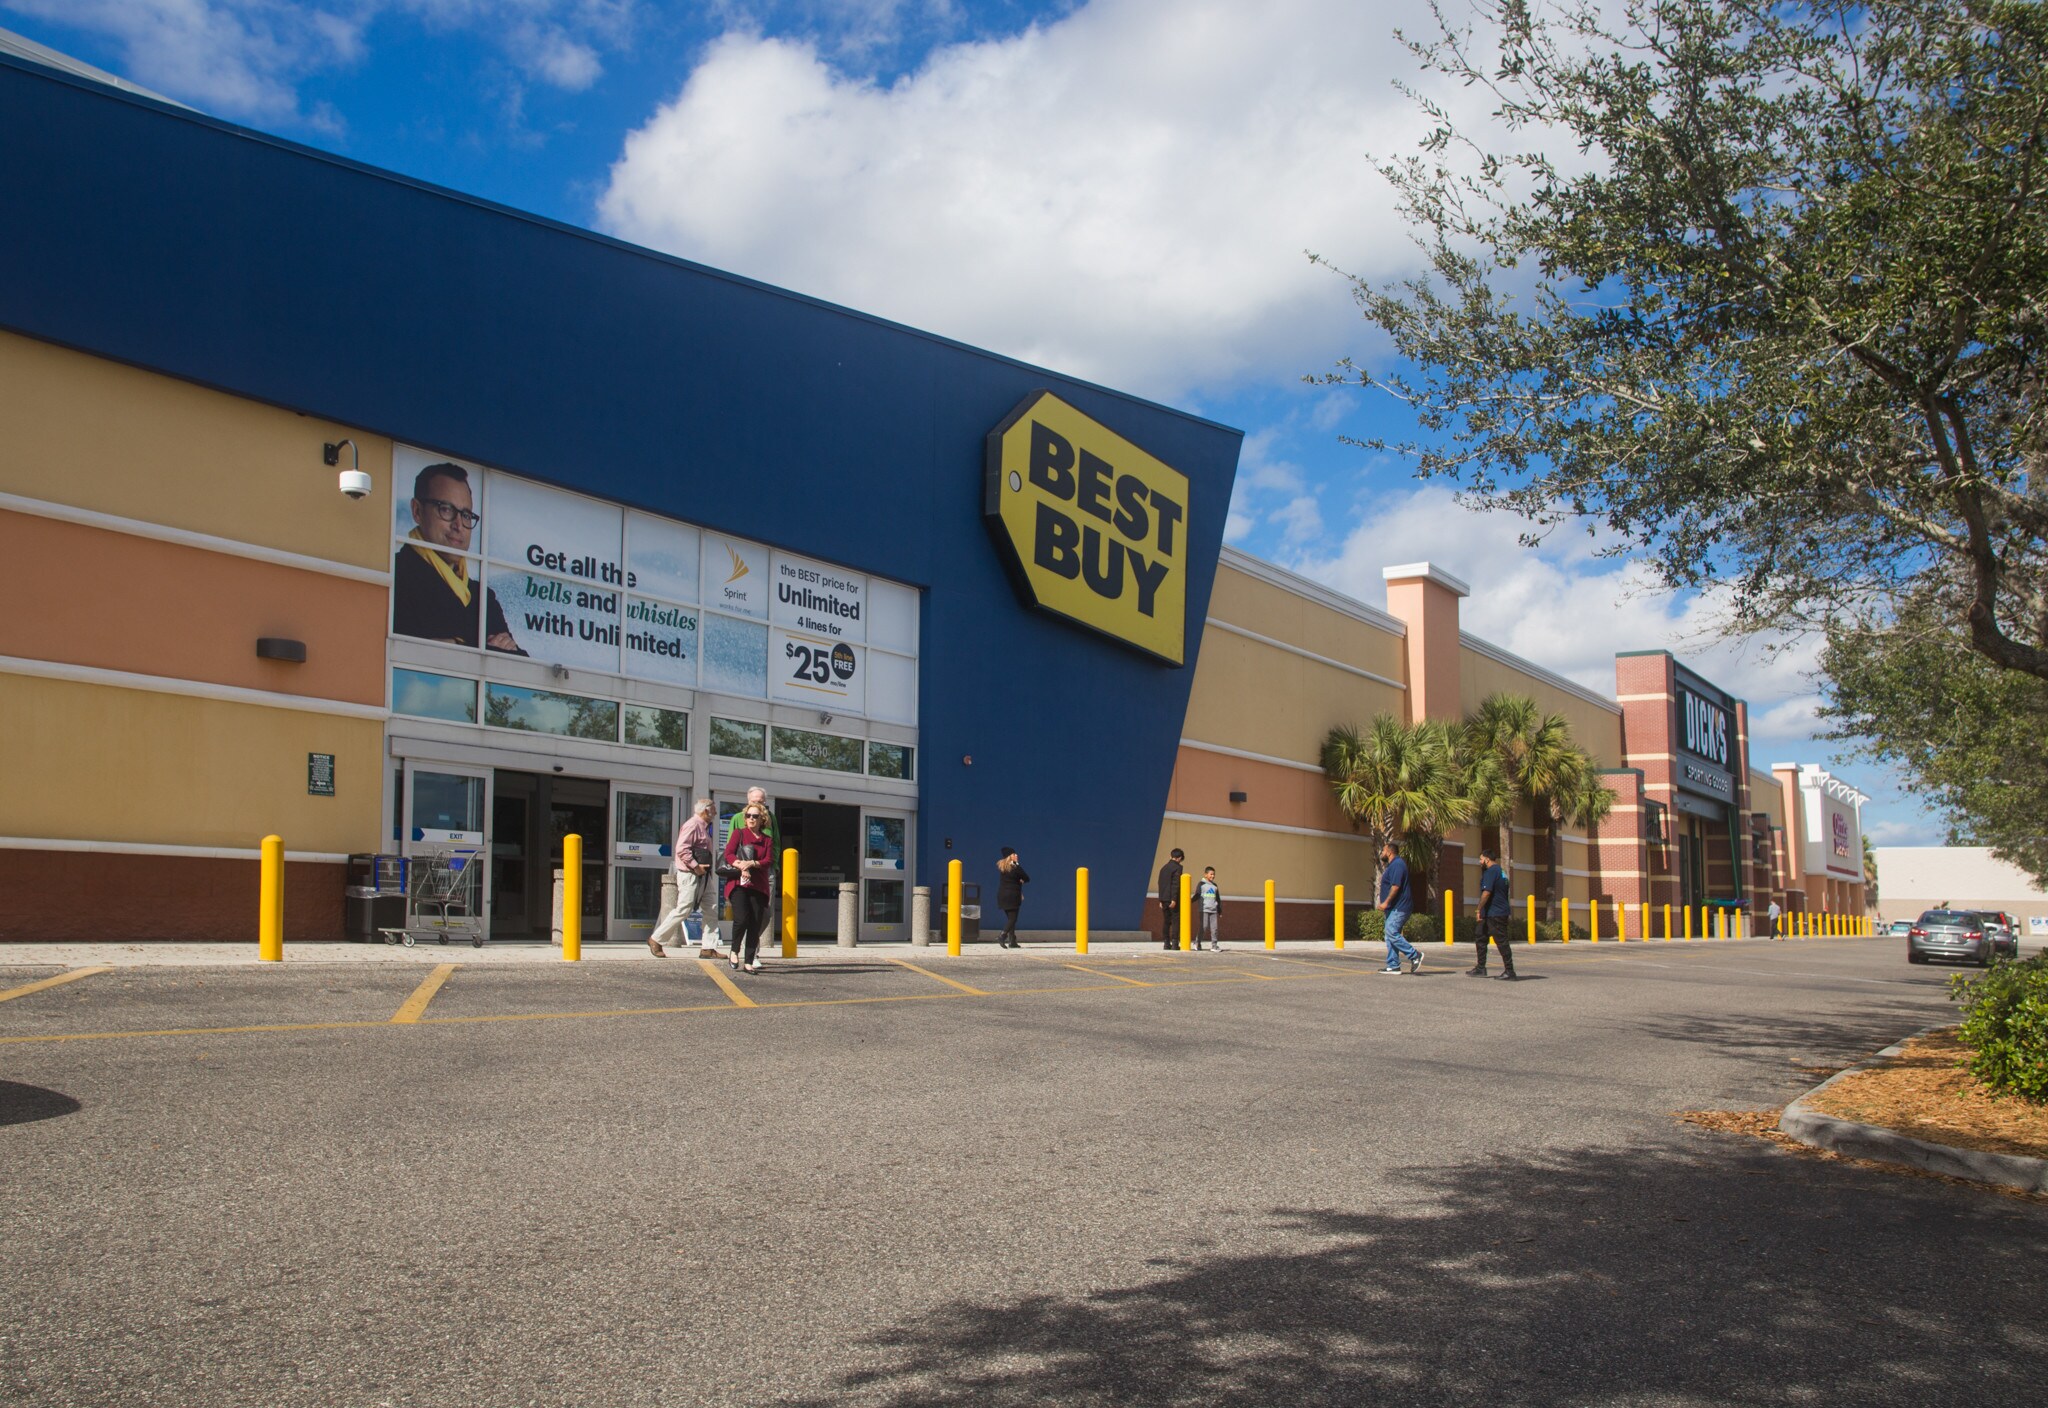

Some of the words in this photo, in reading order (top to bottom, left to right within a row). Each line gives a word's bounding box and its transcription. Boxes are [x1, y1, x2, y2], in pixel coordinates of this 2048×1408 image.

[1029, 419, 1182, 557] BEST
[527, 545, 566, 572] Get
[571, 556, 596, 578] all
[601, 562, 636, 587] the
[1034, 500, 1169, 618] BUY
[724, 587, 748, 601] Sprint
[781, 564, 795, 578] the
[798, 569, 820, 584] BEST
[822, 576, 844, 591] price
[847, 581, 858, 594] for
[525, 576, 572, 605] bells
[576, 591, 616, 614] and
[627, 601, 697, 631] whistles
[778, 582, 860, 620] Unlimited
[525, 611, 573, 638] with
[579, 619, 686, 659] Unlimited.
[797, 616, 804, 627] 4
[805, 618, 827, 632] lines
[828, 622, 842, 636] for
[786, 642, 830, 684] $25
[834, 659, 853, 671] FREE
[1685, 690, 1727, 764] DICK'S
[806, 744, 828, 757] 4210
[1688, 765, 1712, 787] SPORTING
[1712, 775, 1728, 792] GOODS
[449, 832, 464, 840] EXIT
